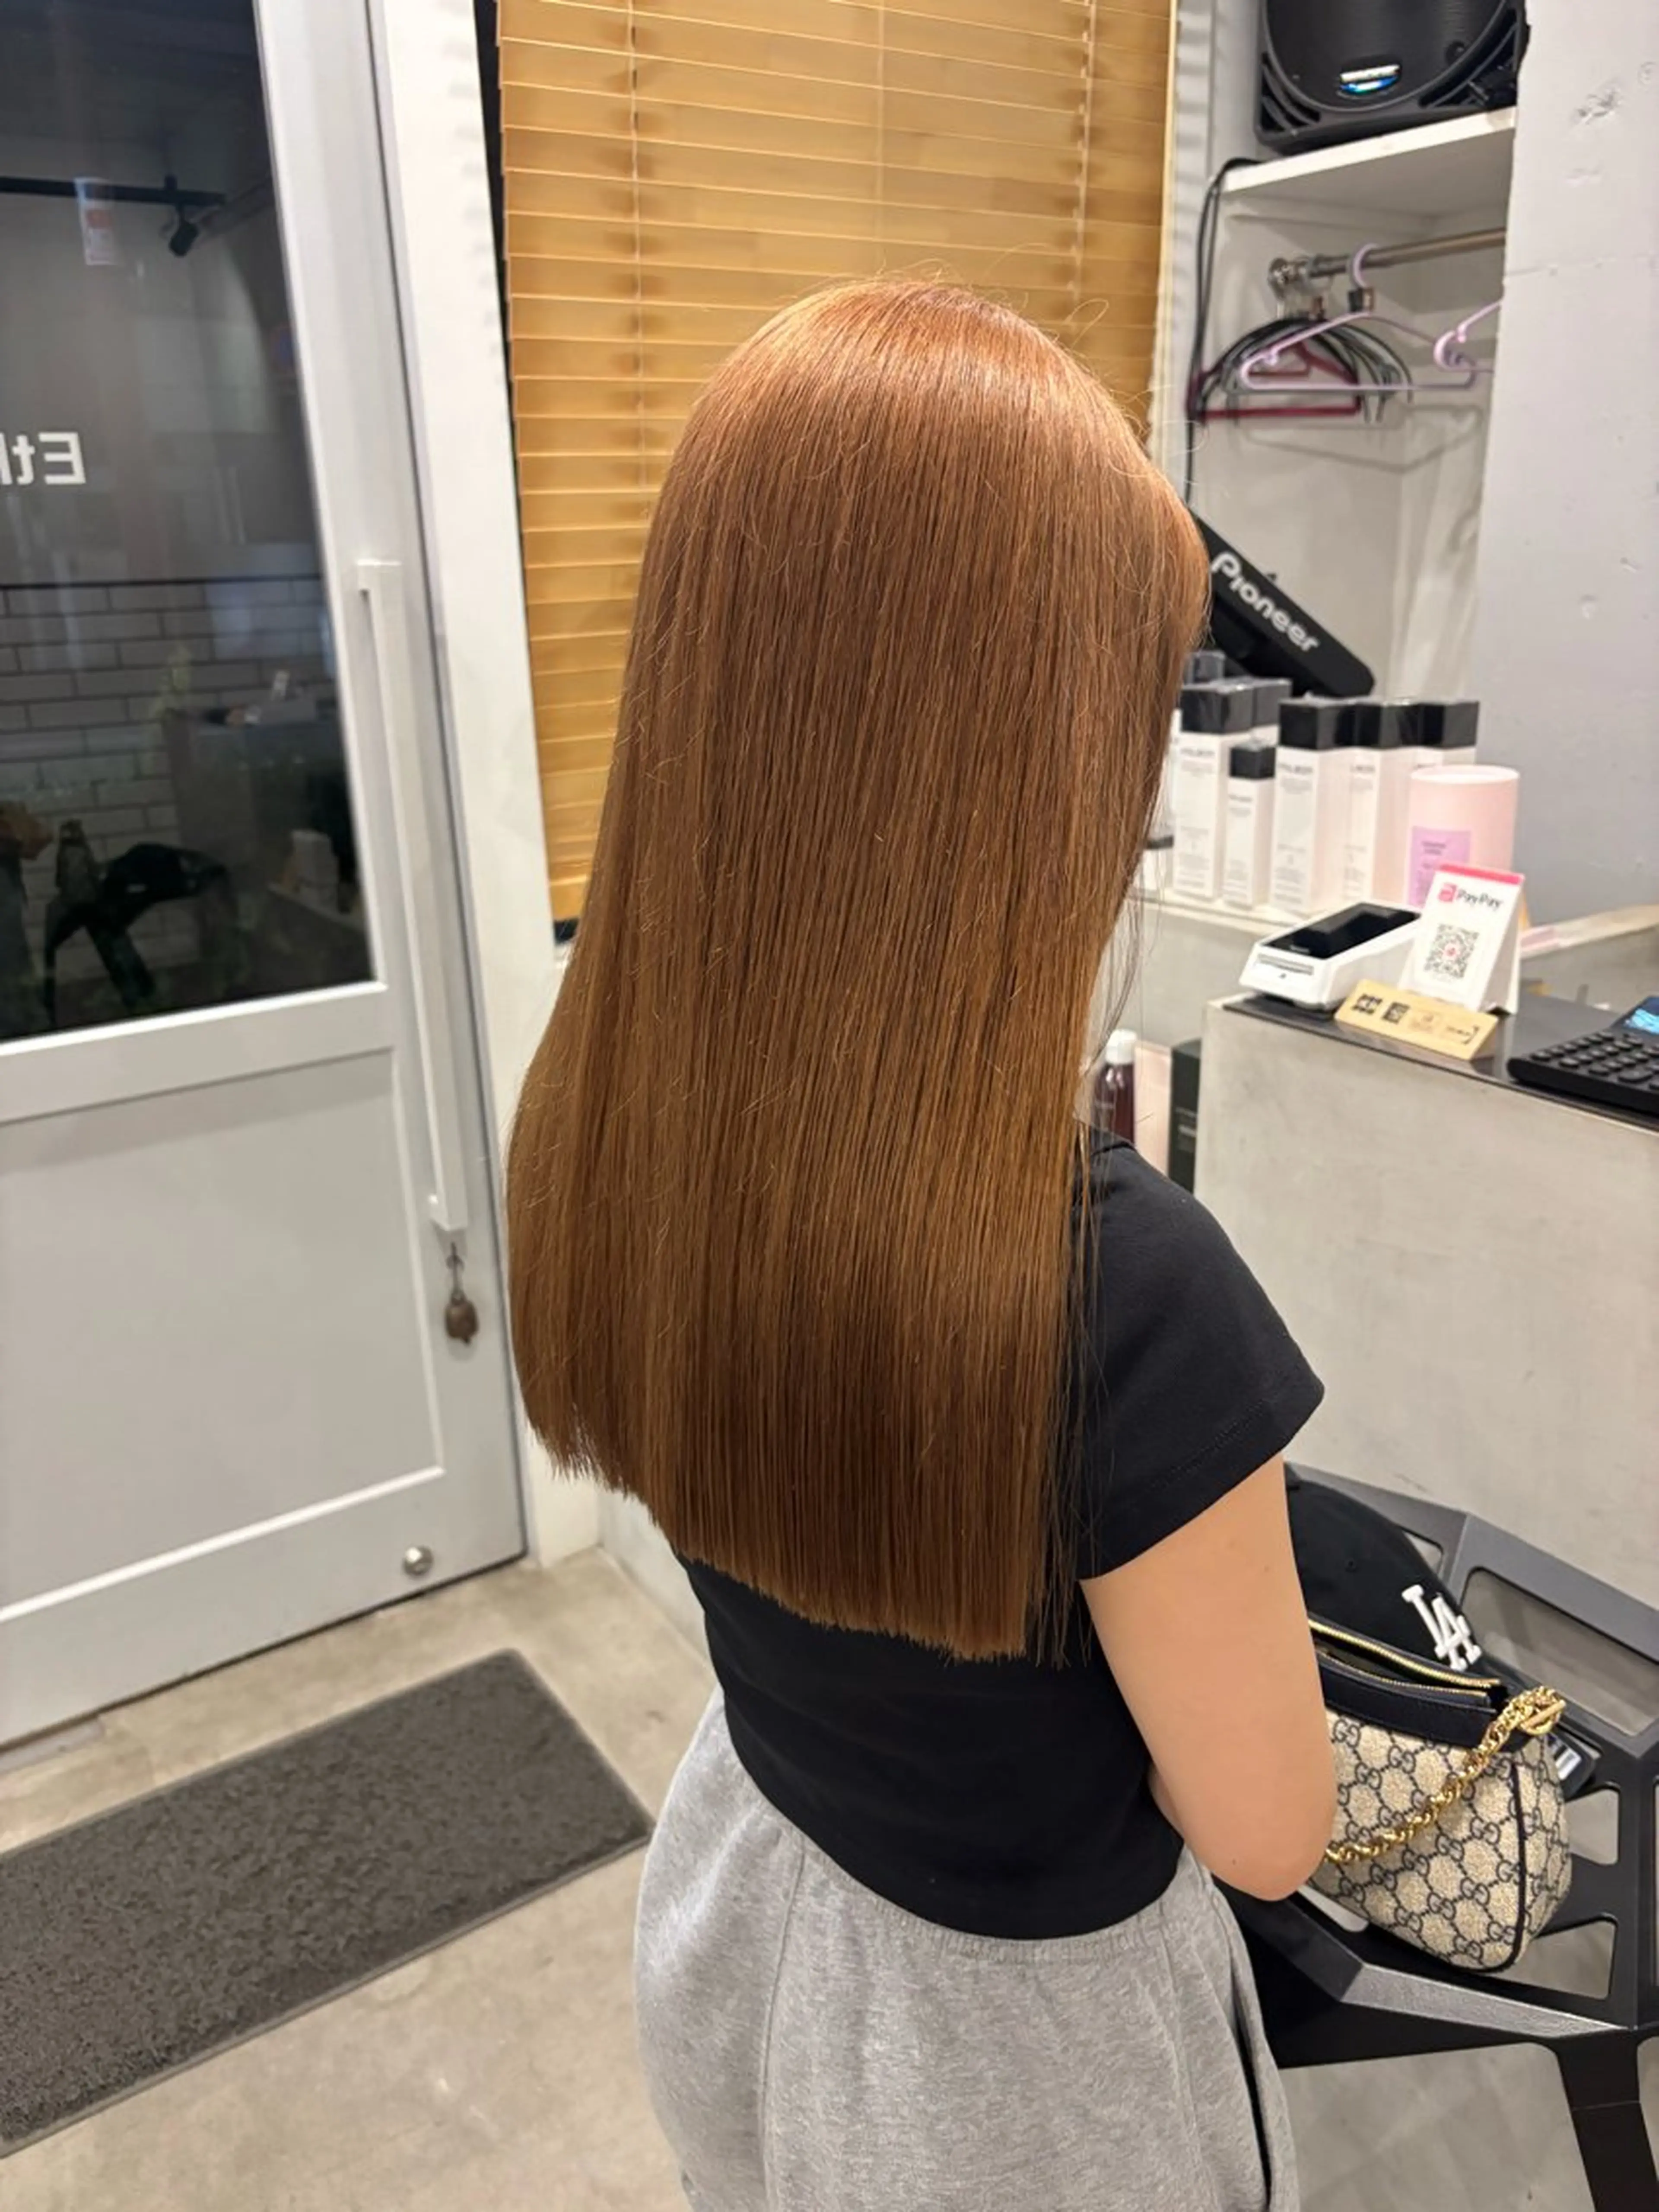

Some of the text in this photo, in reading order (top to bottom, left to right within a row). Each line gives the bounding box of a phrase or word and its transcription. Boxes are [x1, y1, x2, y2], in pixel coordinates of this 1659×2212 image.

[1211, 551, 1319, 652] Pioneer
[1457, 888, 1503, 912] PayPay
[1401, 1584, 1482, 1672] LA
